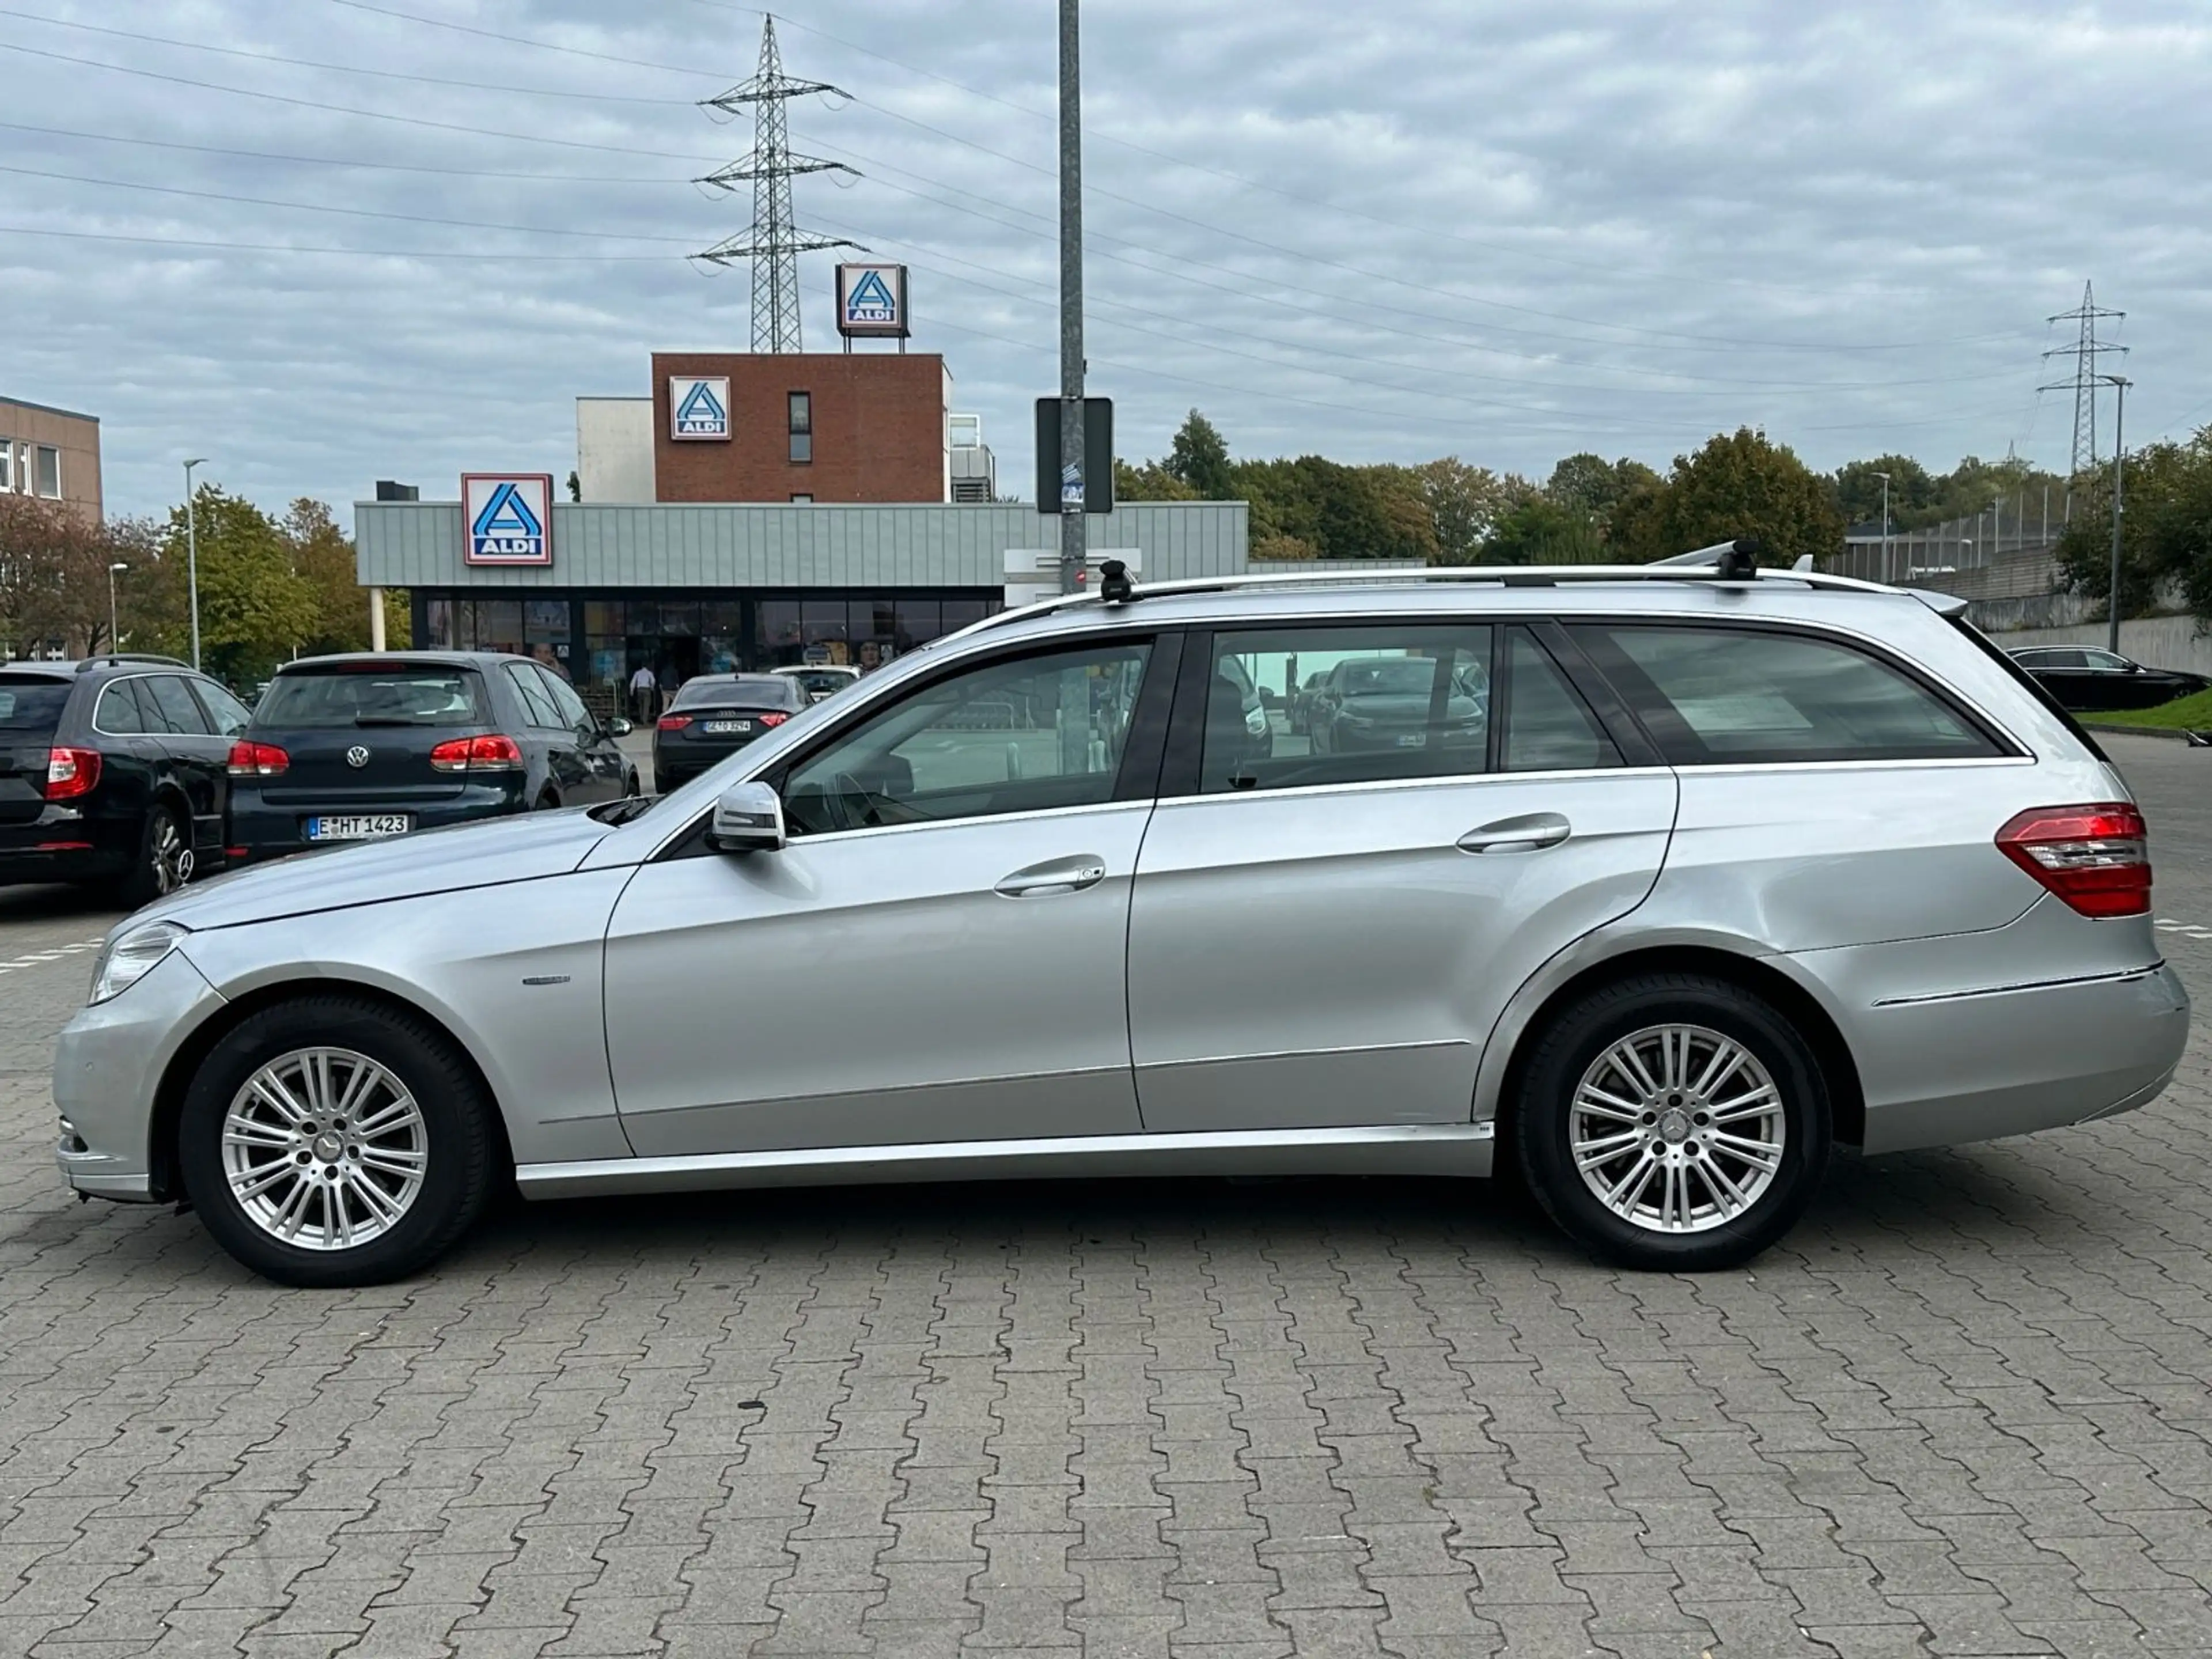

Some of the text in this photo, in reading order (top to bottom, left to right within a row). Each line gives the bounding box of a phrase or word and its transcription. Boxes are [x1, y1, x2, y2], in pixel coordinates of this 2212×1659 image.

[853, 309, 891, 320] ALDI
[682, 421, 721, 432] ALDI
[480, 539, 536, 554] ALDI
[320, 816, 404, 834] E HT 1423
